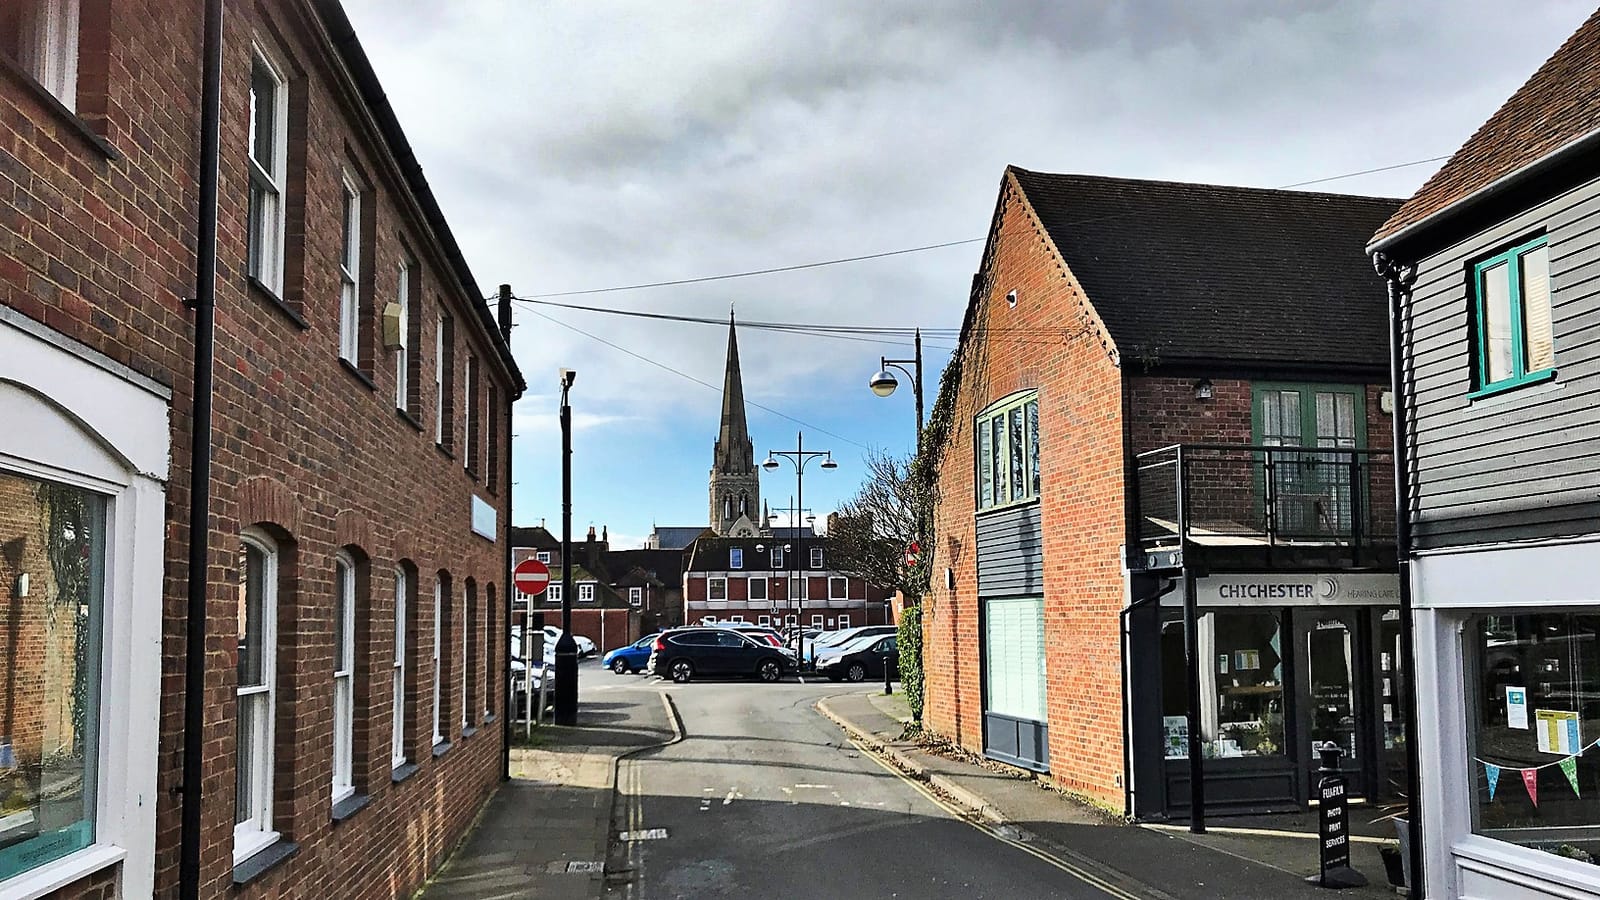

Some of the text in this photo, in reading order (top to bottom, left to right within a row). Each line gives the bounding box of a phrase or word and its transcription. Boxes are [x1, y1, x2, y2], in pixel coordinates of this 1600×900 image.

[1219, 584, 1314, 599] CHICHESTER
[1347, 590, 1377, 599] HEARING
[1322, 784, 1344, 799] FUJIFILM
[1327, 806, 1342, 818] PHOTO
[1328, 822, 1341, 832] PRINT
[1326, 834, 1345, 848] SERVICES
